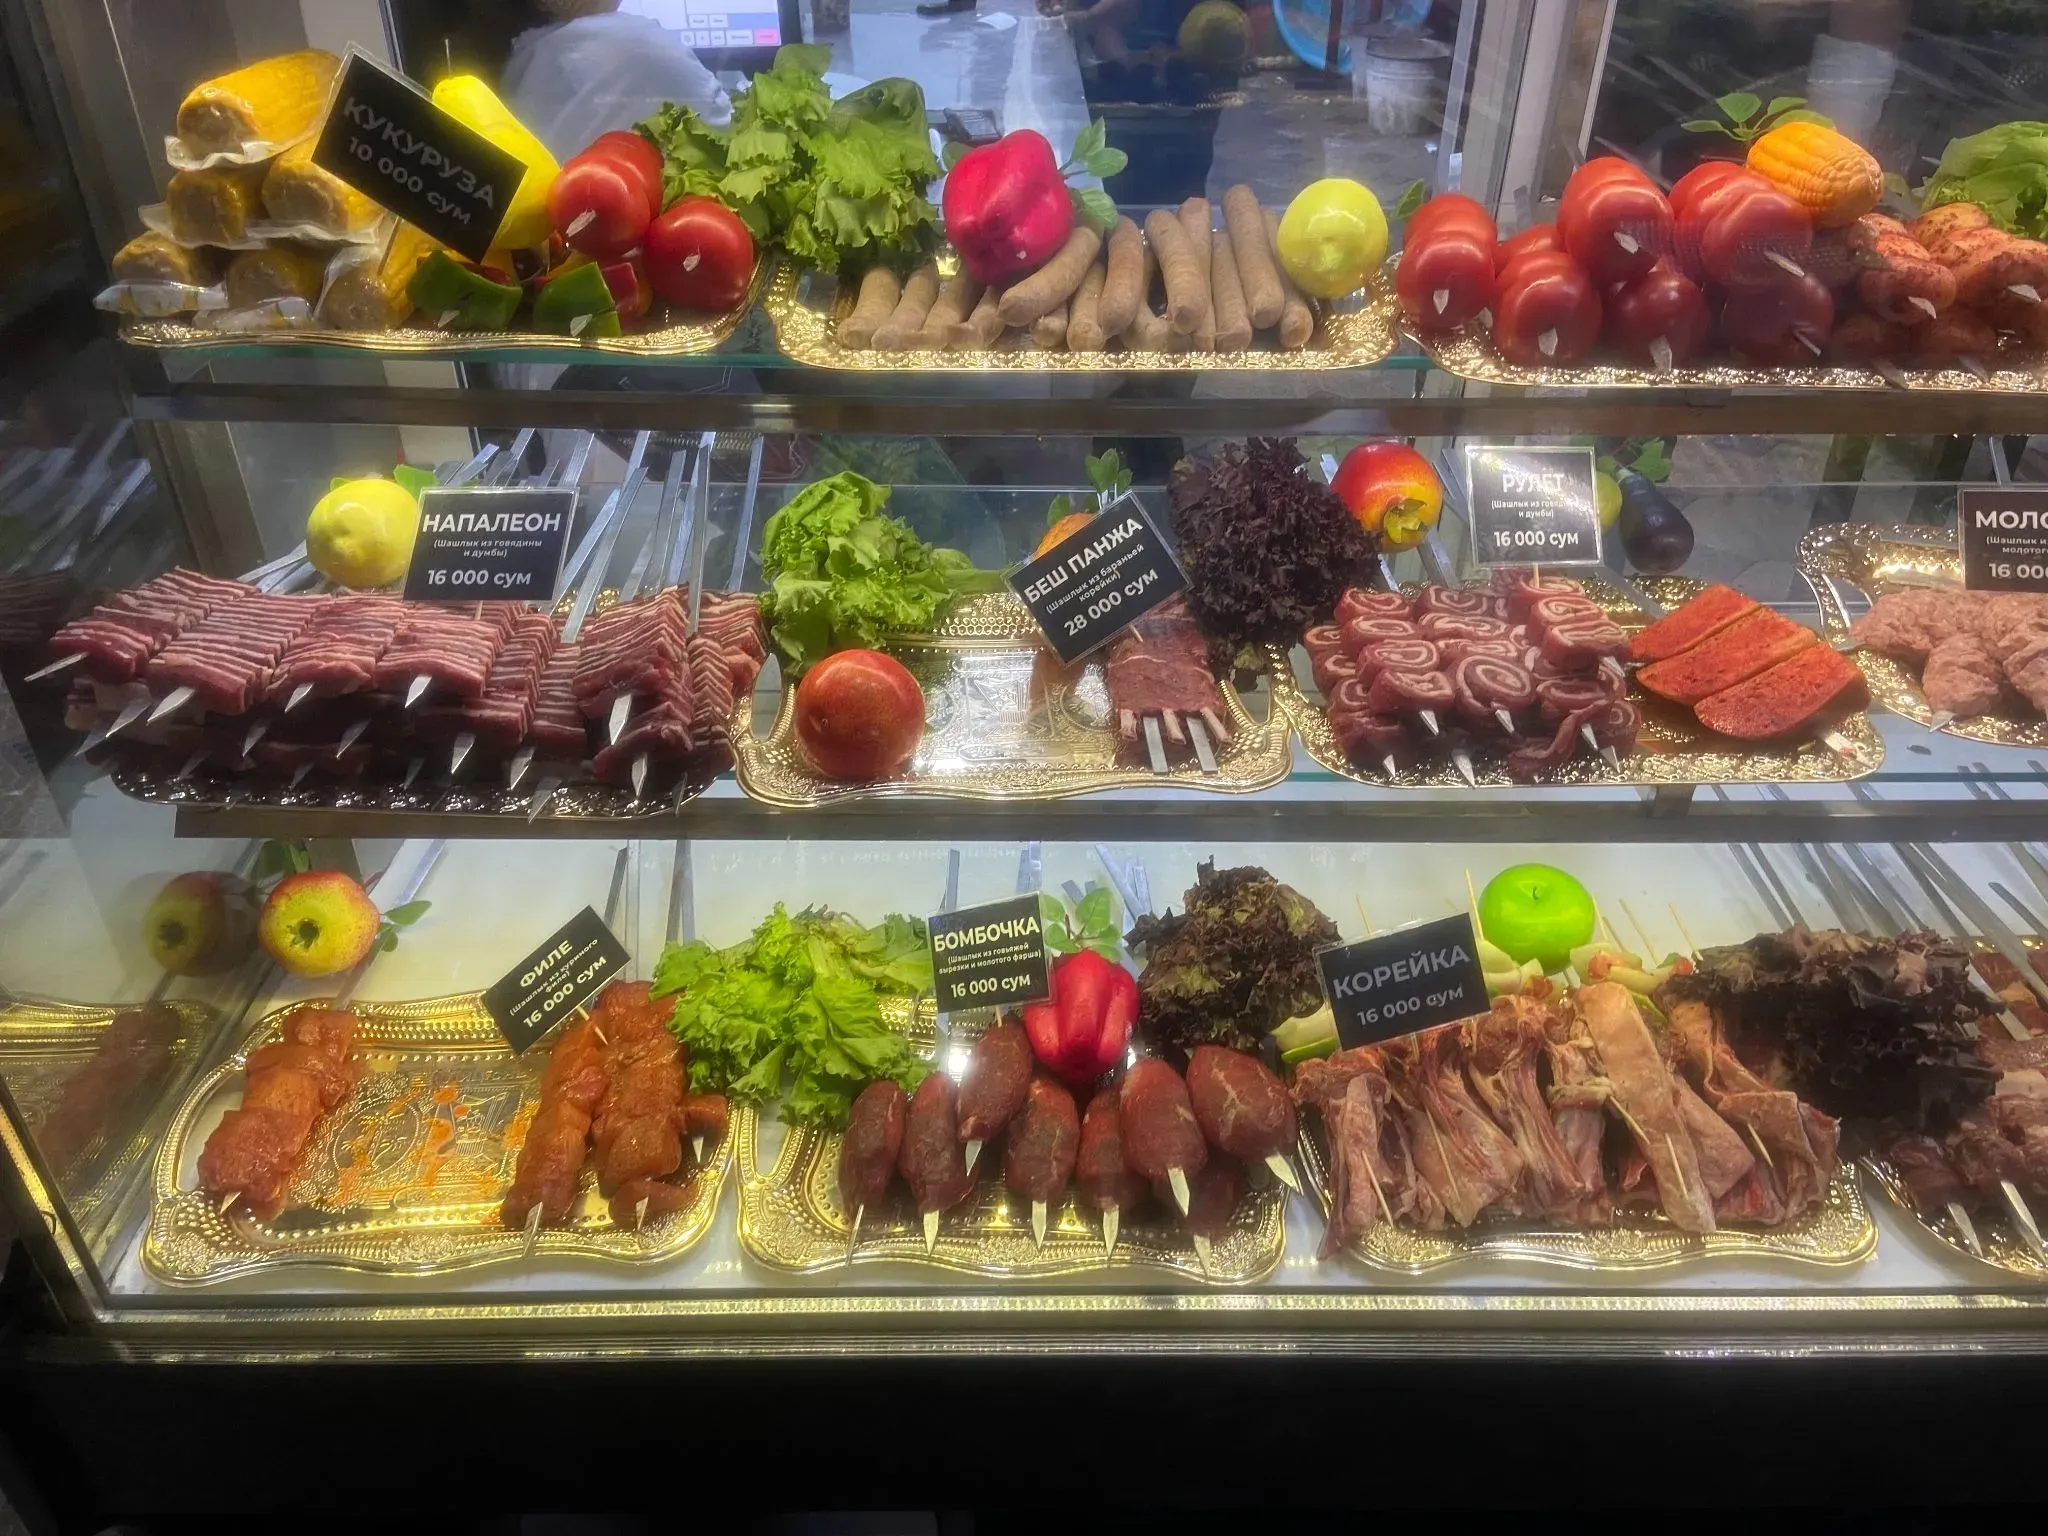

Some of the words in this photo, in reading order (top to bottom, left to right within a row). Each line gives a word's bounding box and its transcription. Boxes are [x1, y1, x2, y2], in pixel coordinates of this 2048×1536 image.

[343, 96, 494, 209] КУКУРУЗА
[349, 136, 372, 161] 10
[378, 157, 423, 192] 000
[426, 191, 471, 225] сум
[1502, 473, 1565, 493] РУЛЕТ
[422, 512, 562, 533] НАПАЛЕОН
[1525, 510, 1554, 519] думбы)
[433, 539, 479, 549] (Шашлык
[494, 540, 543, 548] говядины
[471, 548, 508, 558] думбы)
[1494, 531, 1511, 547] 16
[1515, 530, 1545, 546] 000
[1549, 532, 1579, 548] сум
[1986, 536, 2037, 545] (Шашлык
[1024, 565, 1069, 603] БЕШ
[1067, 518, 1144, 574] ПАНЖА
[1988, 563, 2011, 578] 16
[427, 569, 446, 585] 16
[451, 569, 489, 585] 000
[493, 573, 532, 588] сум
[1046, 581, 1089, 615] (Шашлык
[1088, 575, 1101, 586] из
[1100, 544, 1144, 577] бараньей
[1078, 570, 1121, 602] корейки)
[1064, 614, 1088, 637] 28
[1087, 591, 1122, 620] 000
[1124, 568, 1159, 595] сум
[933, 916, 1040, 952] БОМБОЧКА
[519, 940, 573, 988] ФИЛЕ
[548, 973, 559, 982] из
[560, 939, 598, 974] куриного
[939, 963, 970, 975] вырезки
[976, 956, 1012, 967] молотого
[1012, 949, 1042, 962] фарша)
[948, 952, 982, 964] (Шашлык
[1332, 944, 1471, 1000] КОРЕЙКА
[523, 1009, 543, 1028] 16
[543, 982, 574, 1012] 000
[576, 956, 607, 984] сум
[951, 982, 966, 998] 16
[969, 977, 998, 995] 000
[1001, 974, 1031, 992] сум
[1356, 1008, 1379, 1026] 16
[1382, 996, 1420, 1019] 000
[1426, 986, 1464, 1008] сум
